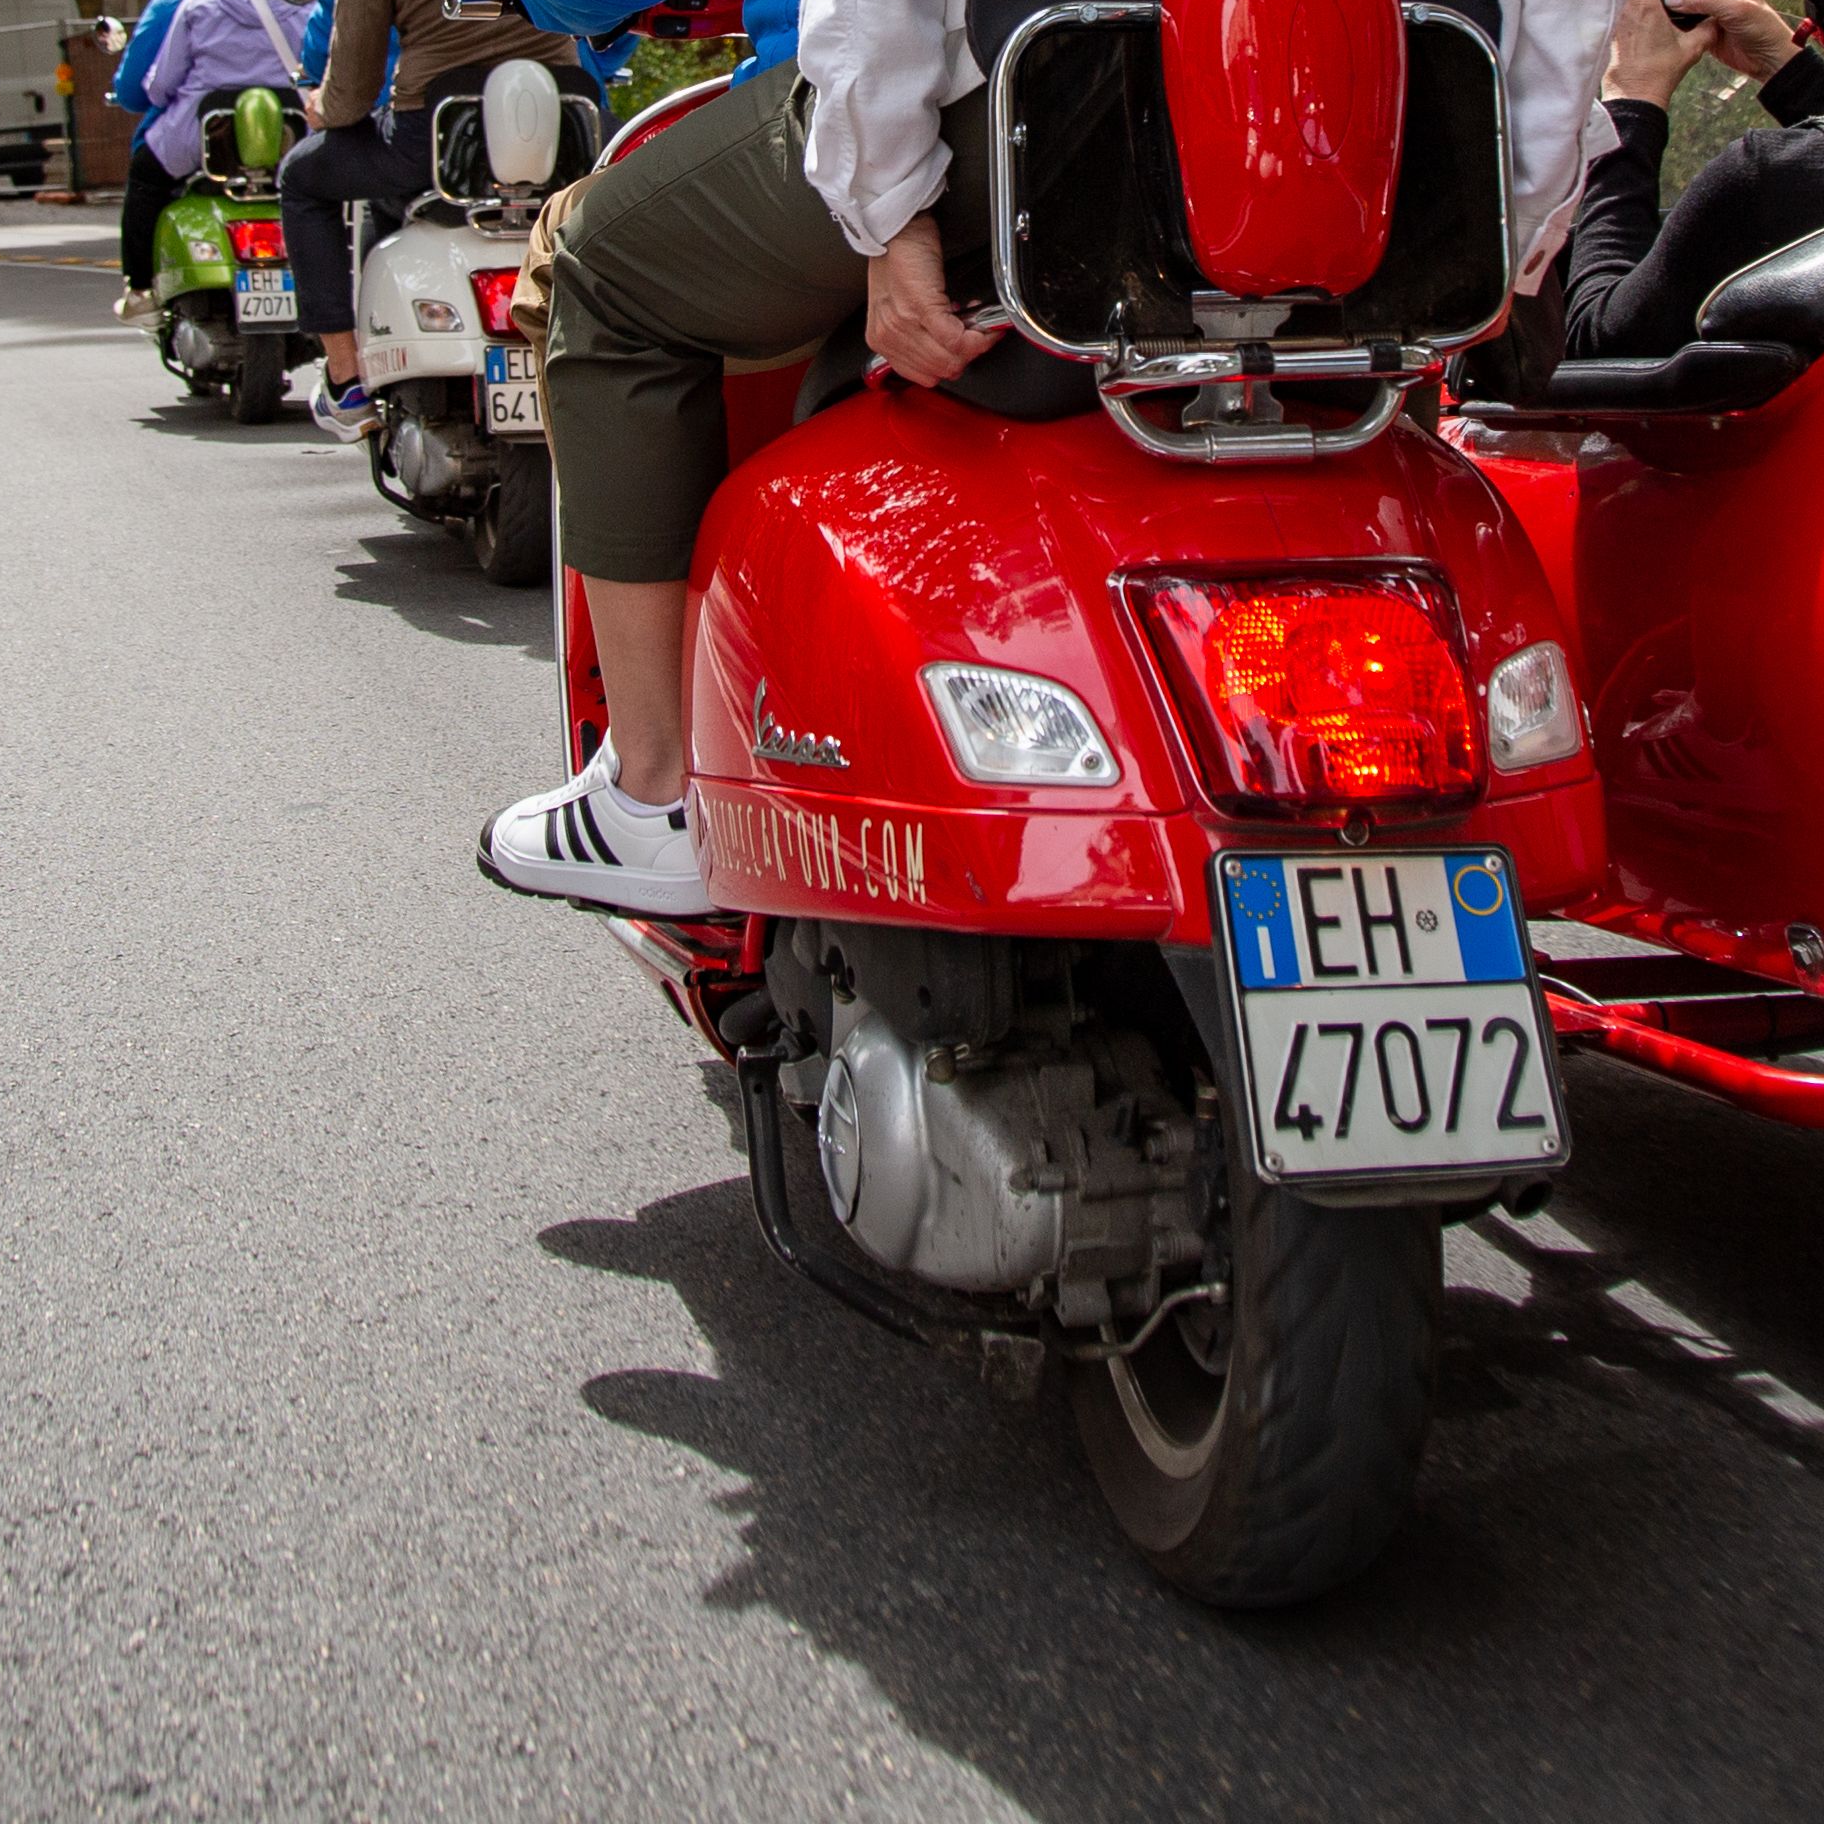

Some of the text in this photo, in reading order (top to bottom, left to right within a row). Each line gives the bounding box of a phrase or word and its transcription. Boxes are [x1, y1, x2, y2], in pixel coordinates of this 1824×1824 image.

[242, 296, 292, 317] 47071
[252, 271, 273, 291] EH
[1296, 866, 1413, 978] EH
[1274, 1016, 1547, 1142] 47072
